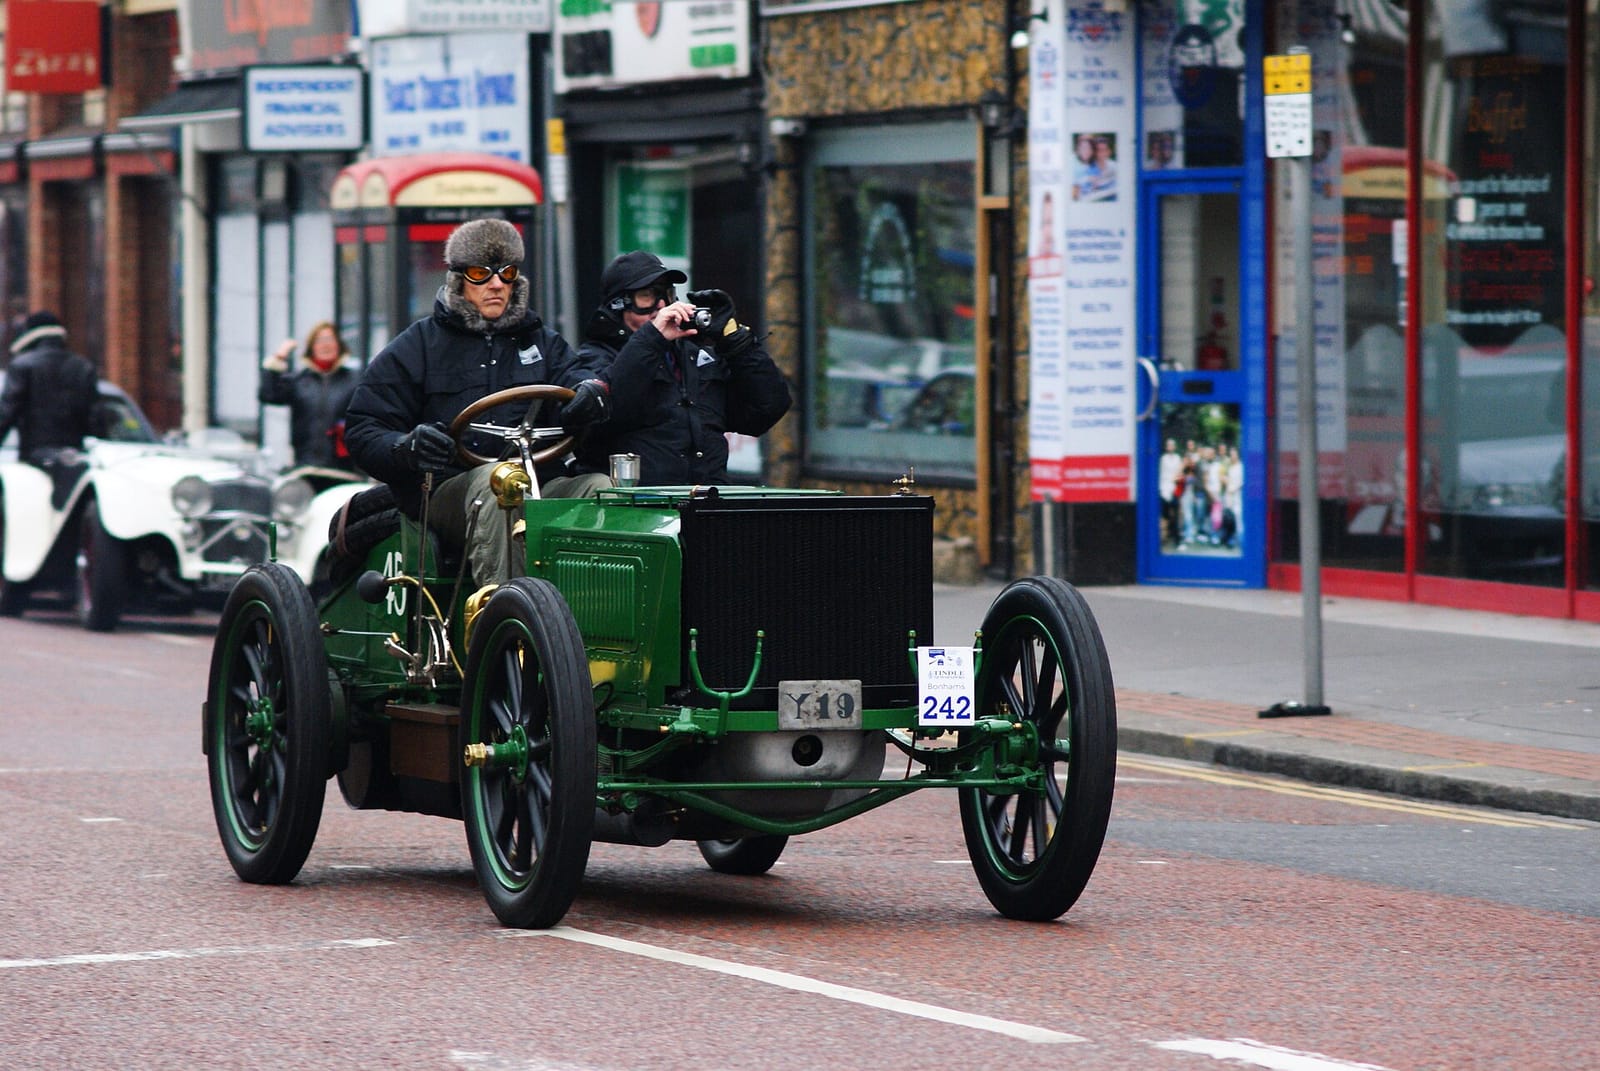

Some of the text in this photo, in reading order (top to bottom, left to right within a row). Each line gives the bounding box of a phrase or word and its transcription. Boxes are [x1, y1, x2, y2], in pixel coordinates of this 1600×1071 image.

[256, 81, 353, 93] INDEPENDENT
[264, 103, 341, 115] FINANCIAL
[923, 695, 971, 720] 242
